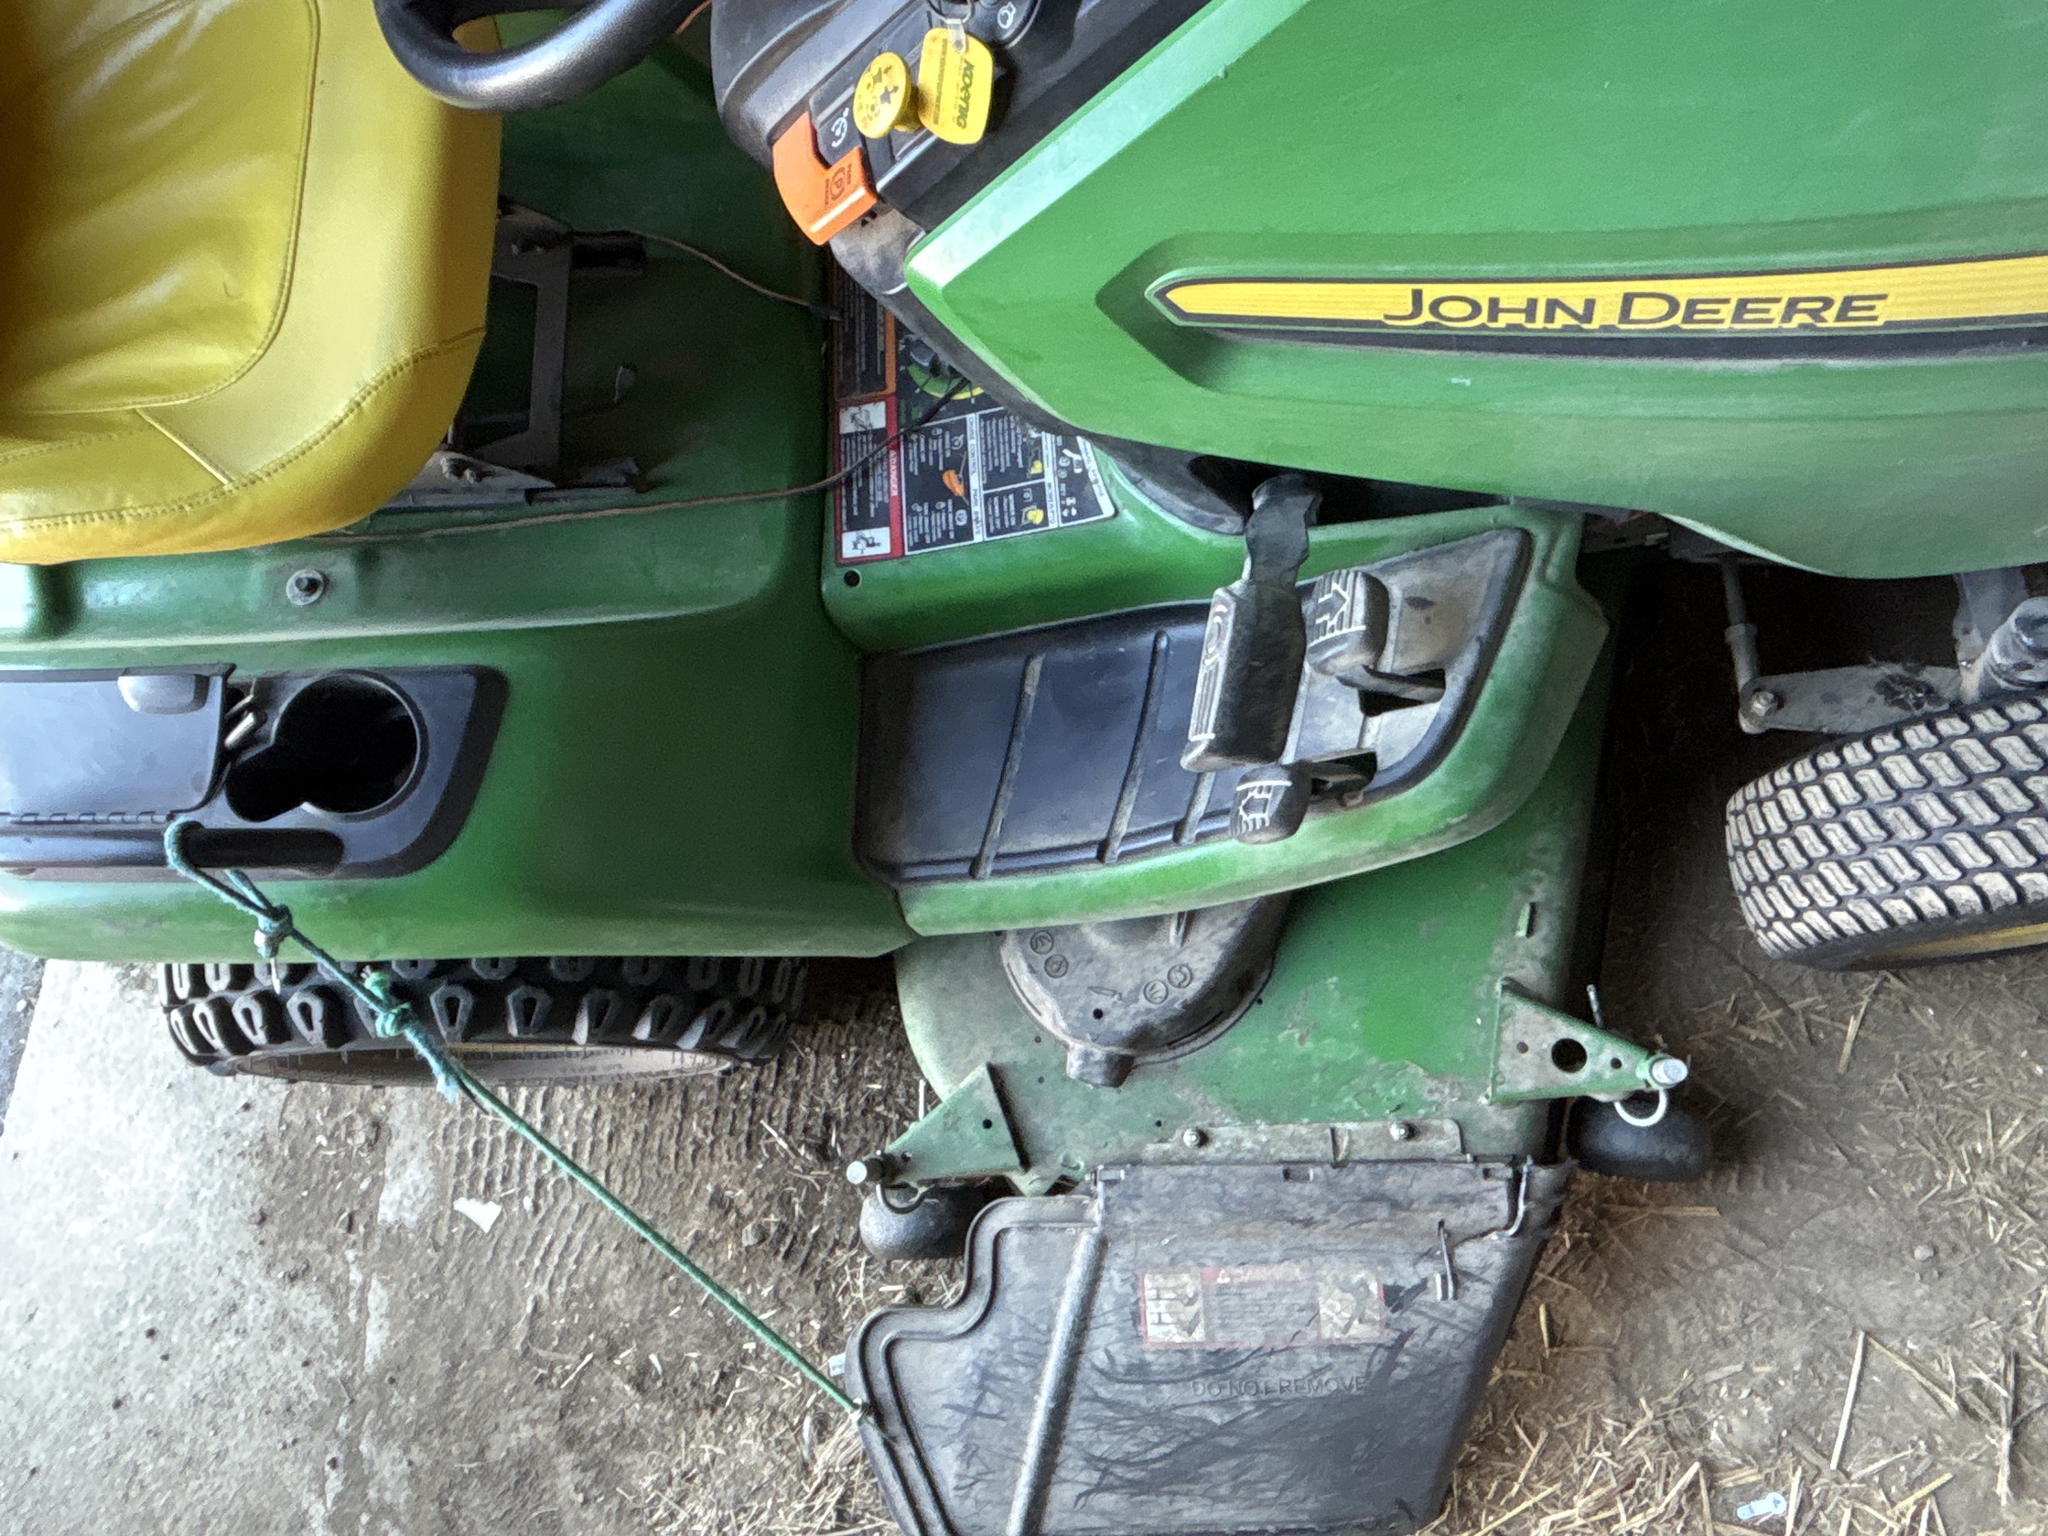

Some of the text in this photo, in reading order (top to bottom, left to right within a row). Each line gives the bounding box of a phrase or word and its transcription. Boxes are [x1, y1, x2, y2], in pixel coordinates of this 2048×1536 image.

[1384, 288, 1888, 326] JOHN DEERE
[889, 457, 898, 497] DANGER
[1191, 1380, 1222, 1397] DO
[1278, 1375, 1367, 1397] REMOVE
